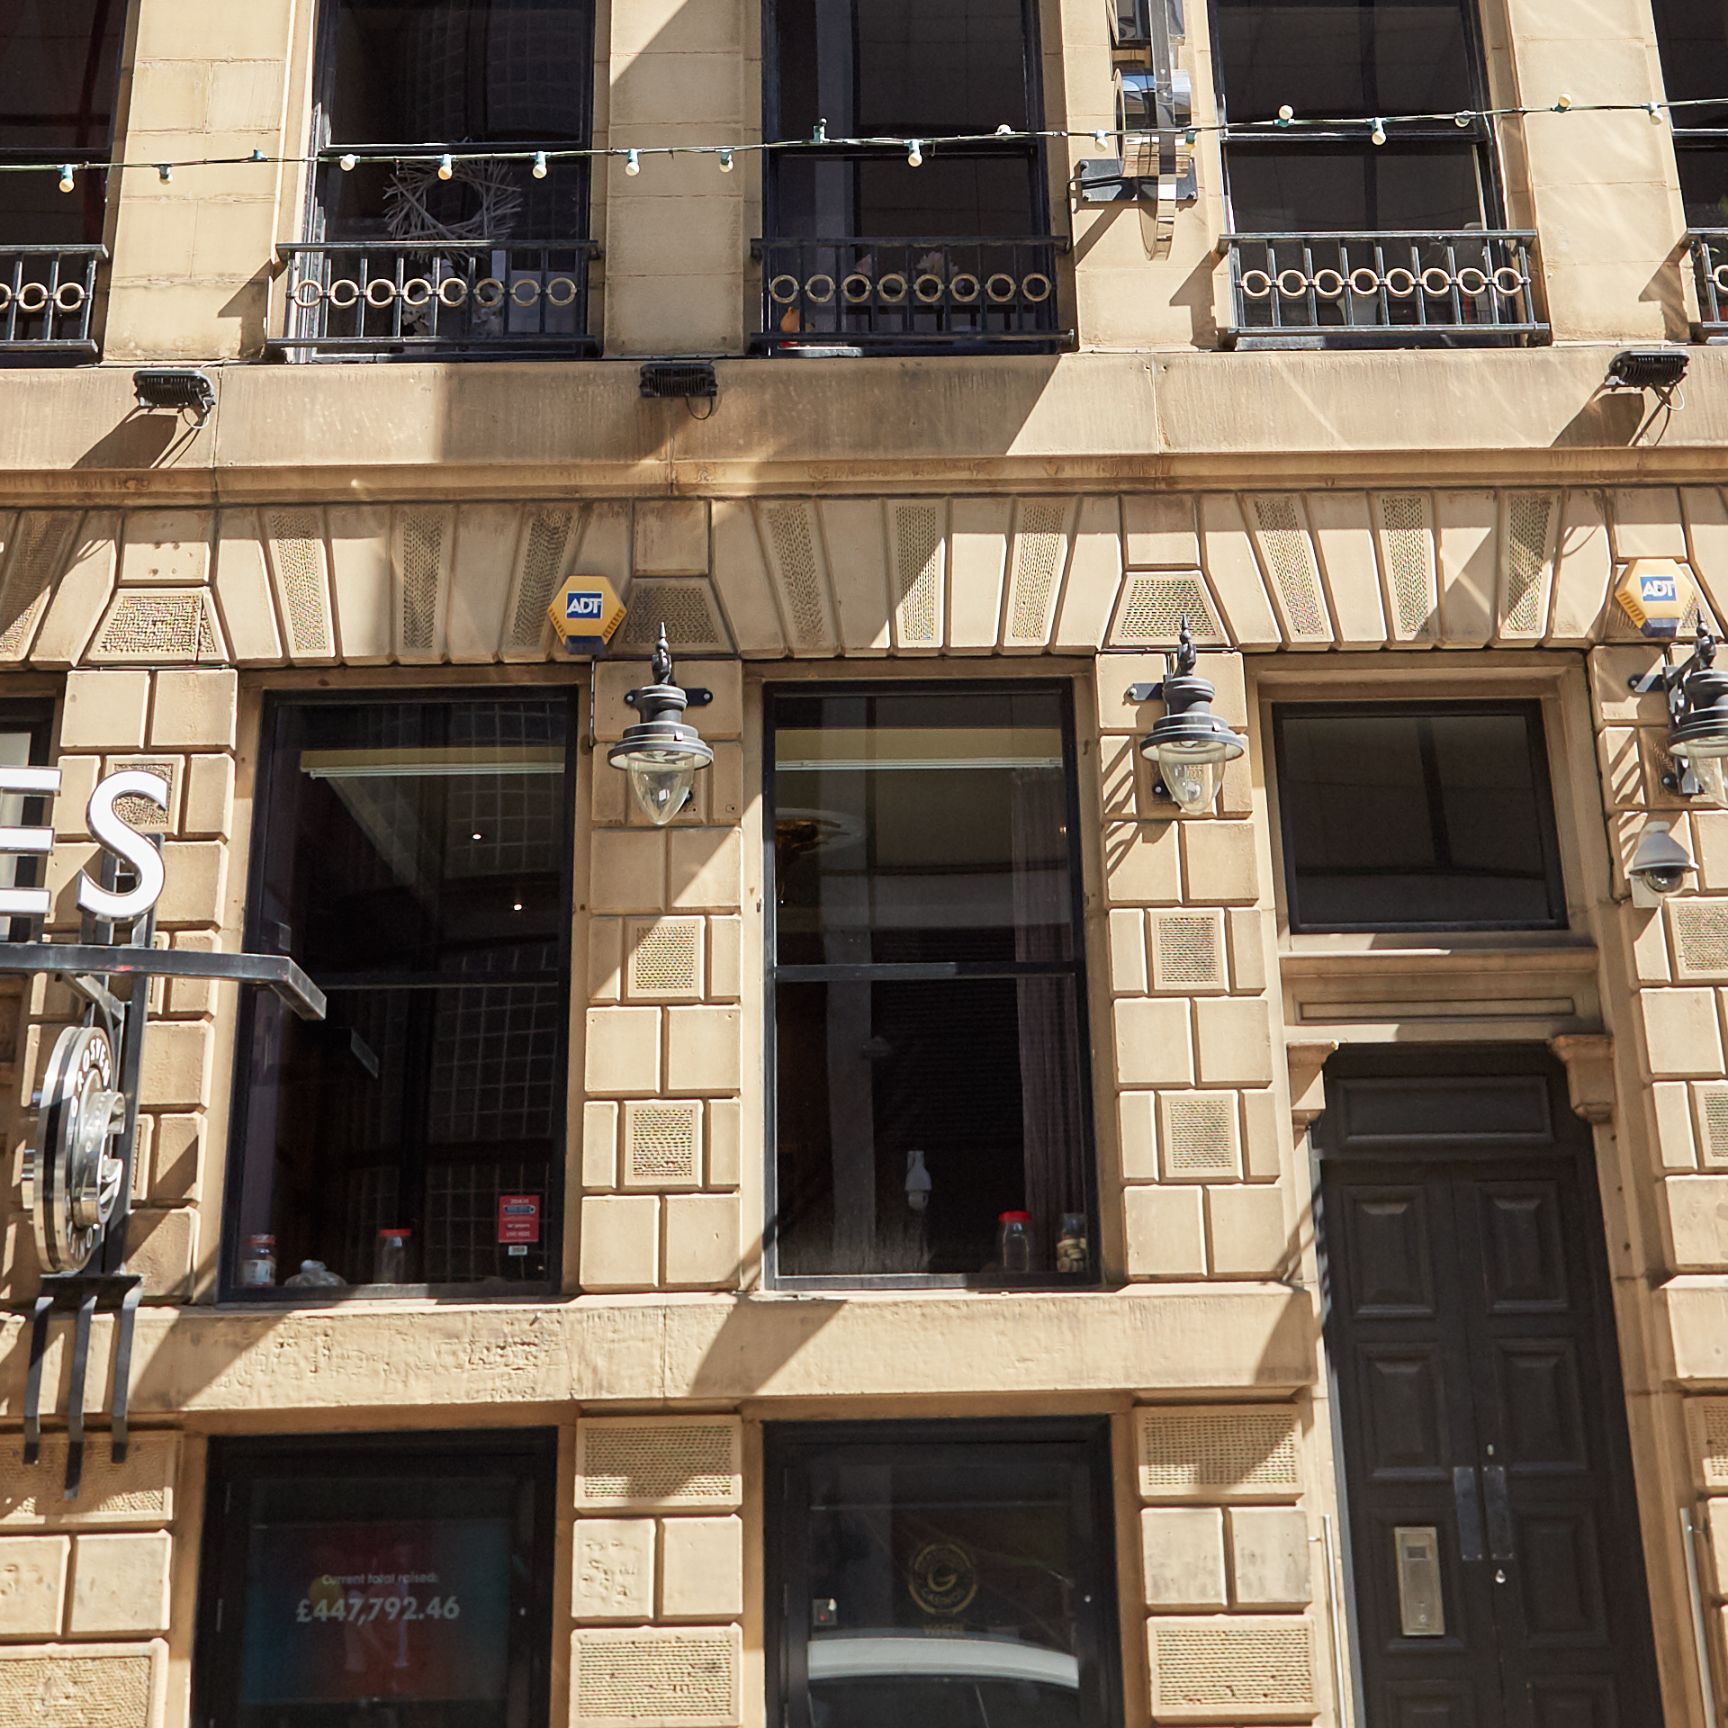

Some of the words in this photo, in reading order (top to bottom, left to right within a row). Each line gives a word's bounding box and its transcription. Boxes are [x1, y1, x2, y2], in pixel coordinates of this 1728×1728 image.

[1642, 580, 1674, 597] ADT
[567, 597, 602, 614] ADT
[321, 1573, 366, 1586] Current
[367, 1573, 396, 1585] total
[295, 1595, 462, 1626] £447,792.46
